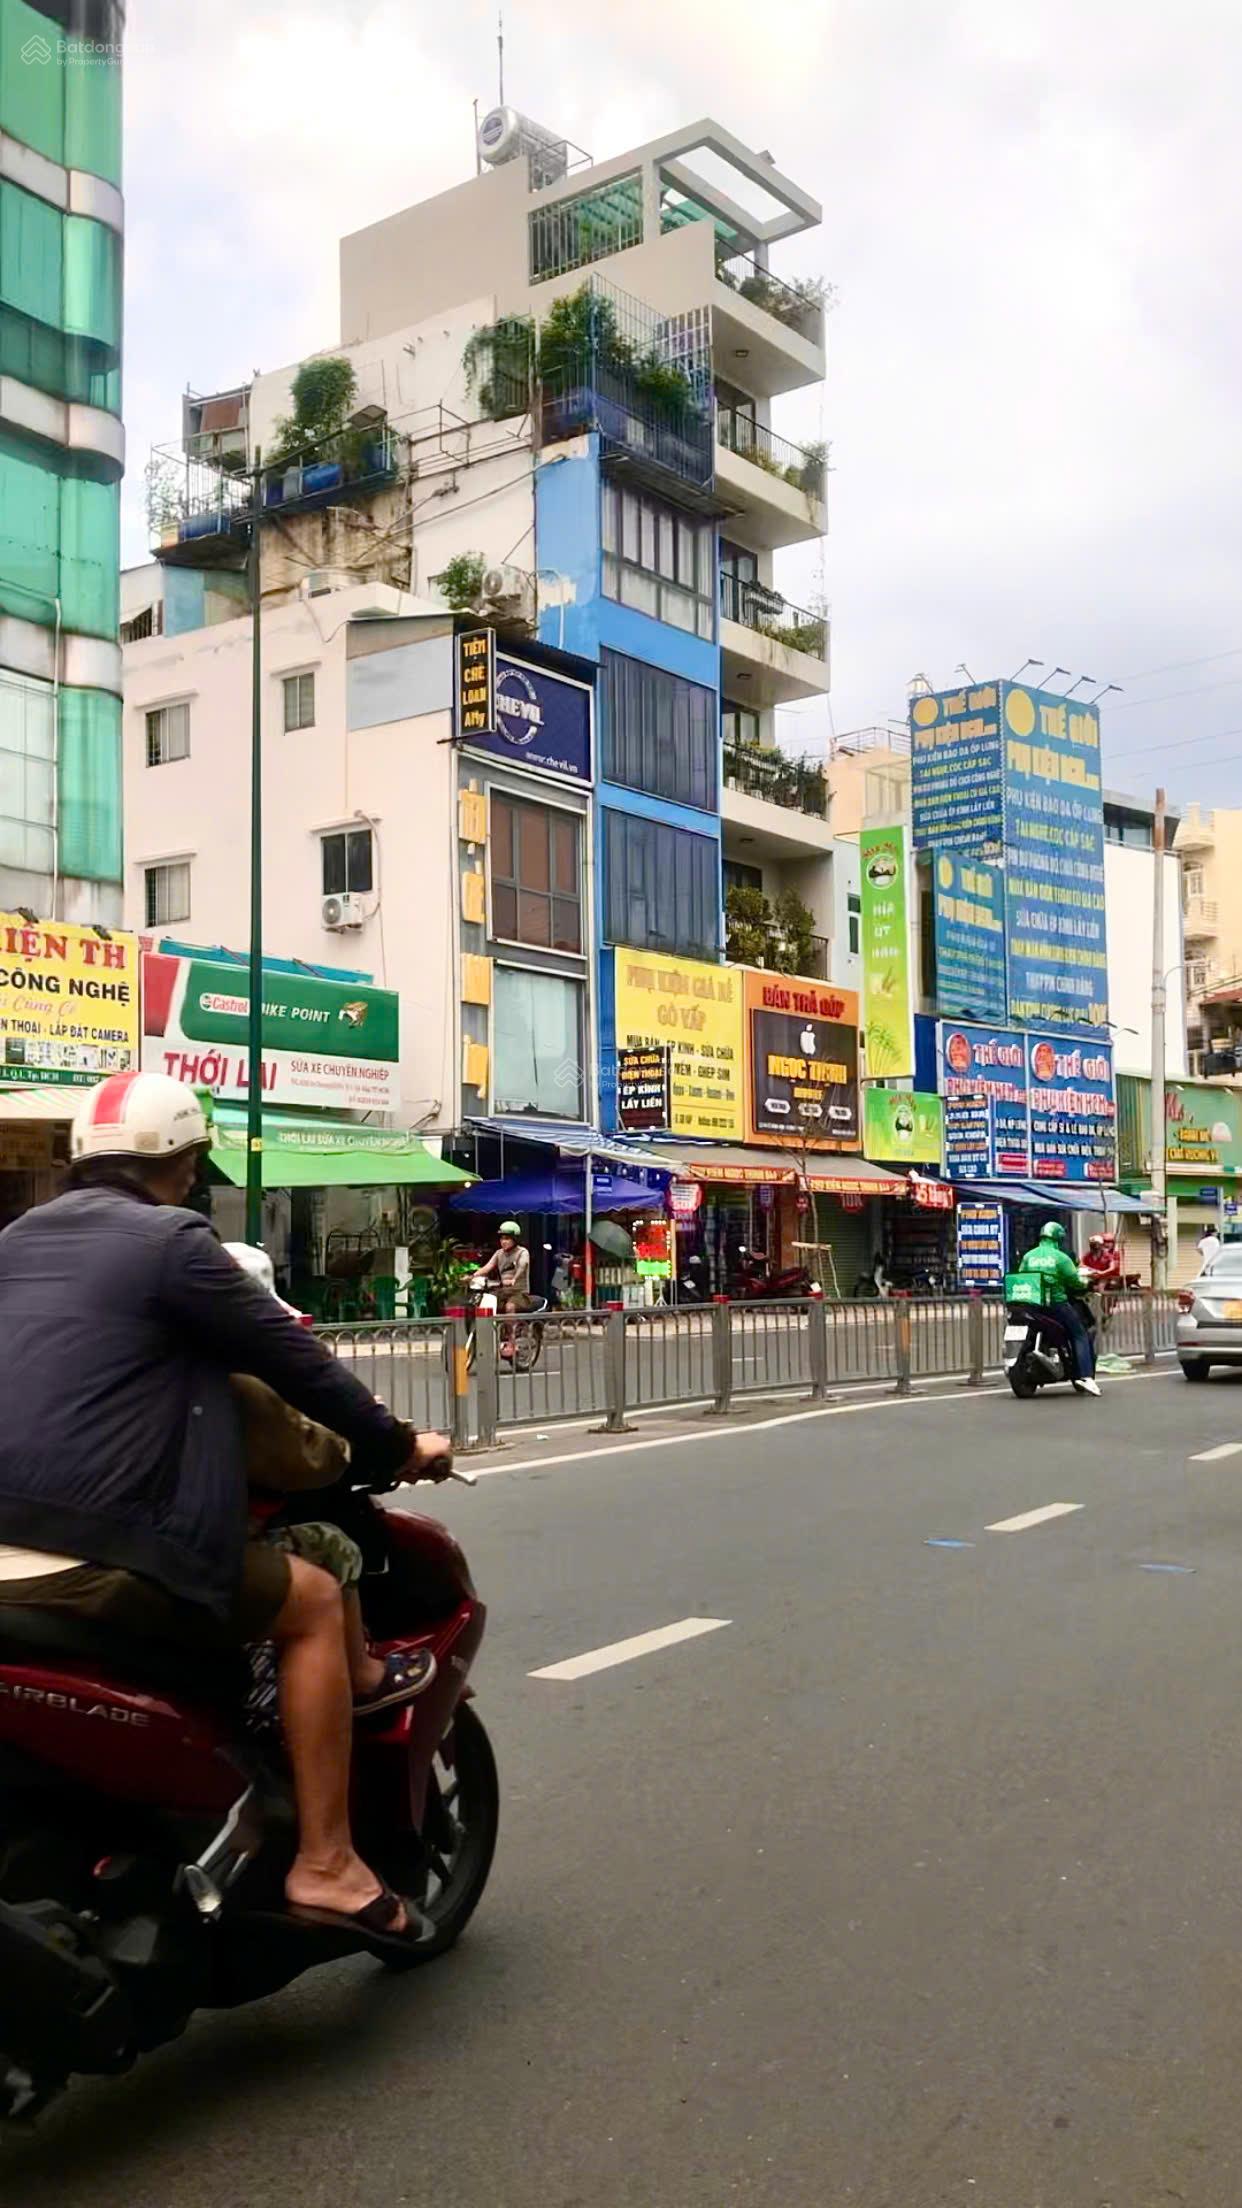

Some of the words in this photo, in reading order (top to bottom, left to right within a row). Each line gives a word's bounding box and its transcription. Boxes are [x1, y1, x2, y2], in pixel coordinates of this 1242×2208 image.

[69, 978, 131, 1007] NGHỆ
[212, 996, 249, 1013] Castrol
[292, 1009, 331, 1023] POINT
[12, 1019, 41, 1037] THOẠI
[91, 1027, 129, 1043] CAMERA
[311, 1062, 321, 1075] XE
[323, 1063, 358, 1077] CHUYÊN
[768, 1055, 806, 1083] NGỌC
[1055, 1049, 1081, 1078] THẾ
